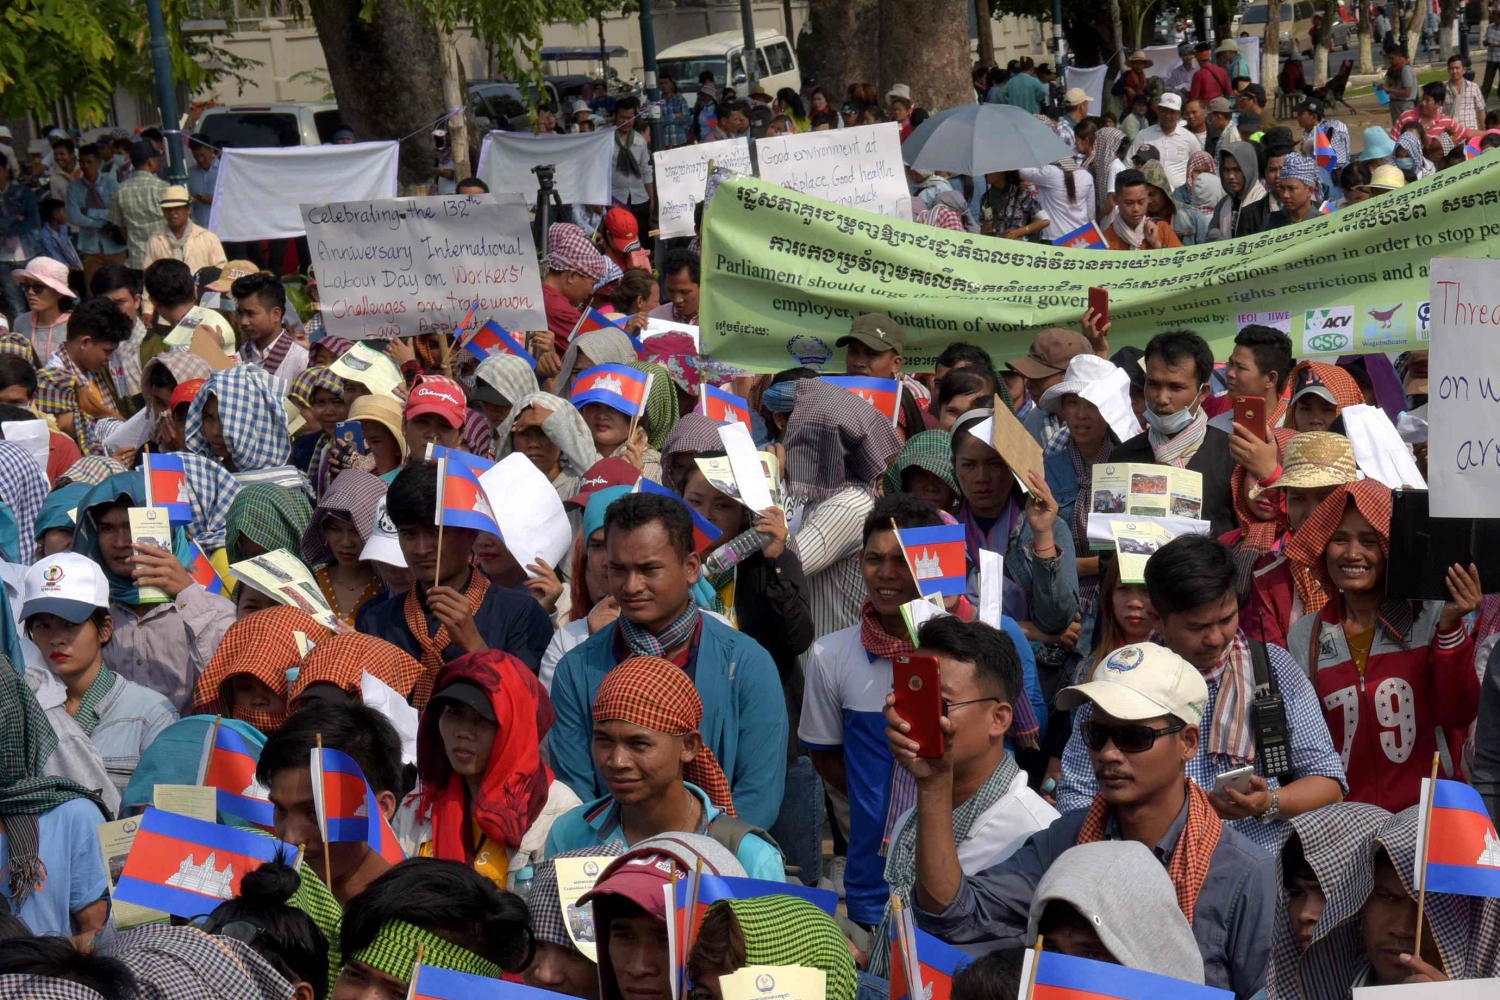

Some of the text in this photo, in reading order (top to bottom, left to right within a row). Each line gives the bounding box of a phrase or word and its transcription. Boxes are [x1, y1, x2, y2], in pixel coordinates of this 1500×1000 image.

[762, 139, 790, 165] Good
[865, 131, 877, 153] at
[832, 165, 855, 187] Good
[859, 159, 895, 182] health
[855, 183, 879, 205] back
[308, 203, 401, 230] Celebrating
[317, 236, 525, 271] Anniversary International
[716, 253, 803, 286] Parliament
[807, 275, 866, 294] should
[1217, 263, 1279, 285] serious
[1284, 252, 1338, 272] action
[1343, 244, 1360, 260] in
[1365, 236, 1412, 255] order
[1415, 233, 1433, 248] to
[1438, 226, 1475, 245] stop
[322, 271, 377, 289] Labour
[382, 270, 419, 296] Day
[424, 273, 447, 287] on
[331, 295, 407, 324] Challenges
[417, 302, 443, 314] on
[772, 297, 854, 321] employer,
[969, 317, 983, 333] of
[1172, 295, 1222, 312] union
[1226, 285, 1277, 307] rights
[1281, 270, 1378, 294] restrictions
[1382, 263, 1414, 281] and
[365, 323, 402, 338] Law
[1156, 312, 1230, 328] Supported by:
[1322, 315, 1352, 329] ACV
[1311, 333, 1344, 350] CSC
[1362, 338, 1408, 348] WageIndicator
[418, 387, 459, 406] Champion
[1439, 375, 1470, 401] on
